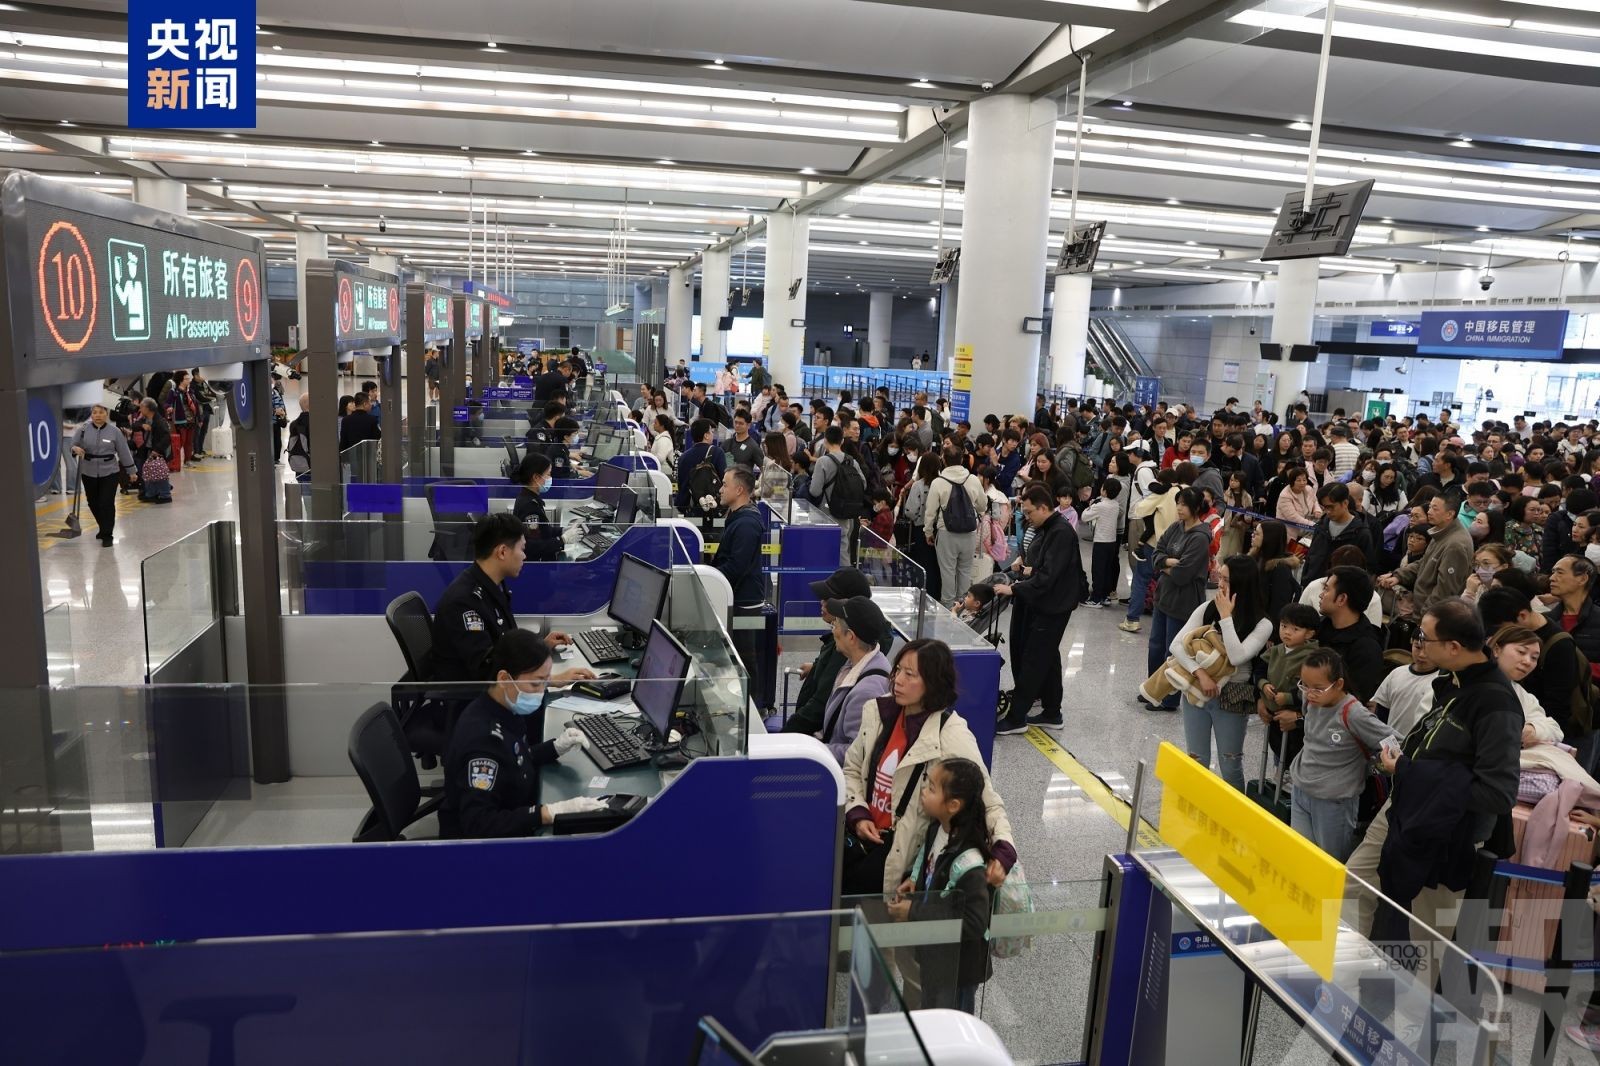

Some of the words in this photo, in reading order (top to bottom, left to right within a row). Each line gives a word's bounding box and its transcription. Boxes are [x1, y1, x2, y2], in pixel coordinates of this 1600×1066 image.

[52, 251, 86, 321] 10
[163, 249, 229, 301] 所有旅客
[166, 313, 179, 340] All
[180, 313, 230, 343] Passengers
[1464, 320, 1536, 334] 中国移民管理
[1486, 335, 1531, 344] IMMIGRATION
[240, 382, 247, 407] 9
[28, 420, 51, 463] 10
[1341, 1004, 1413, 1066] 中国移民管
